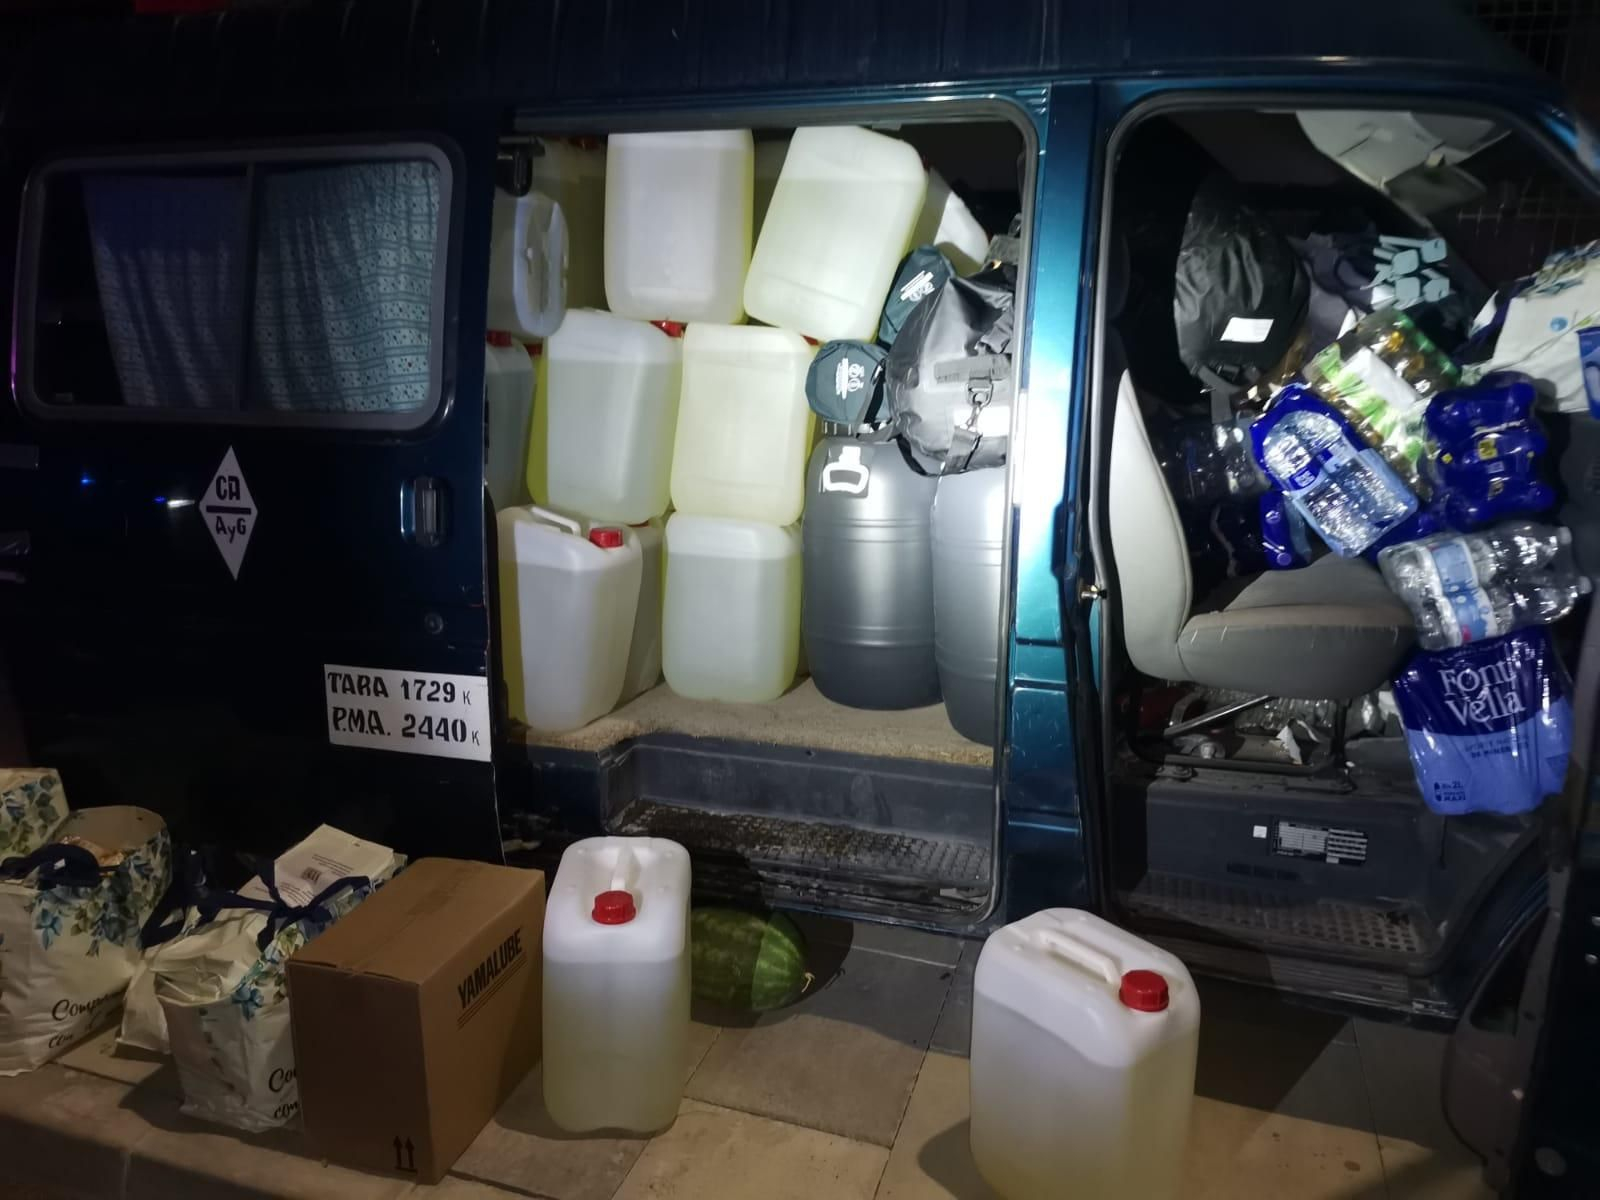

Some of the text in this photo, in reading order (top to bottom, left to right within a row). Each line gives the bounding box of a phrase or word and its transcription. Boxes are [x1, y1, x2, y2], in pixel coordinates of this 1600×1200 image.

[215, 515, 247, 544] AyG
[327, 671, 389, 698] TARA
[401, 678, 456, 703] 1729
[332, 706, 391, 736] P.M.A.
[401, 713, 467, 743] 2440
[1444, 686, 1527, 727] Vella
[457, 927, 523, 1009] YAMALUBE
